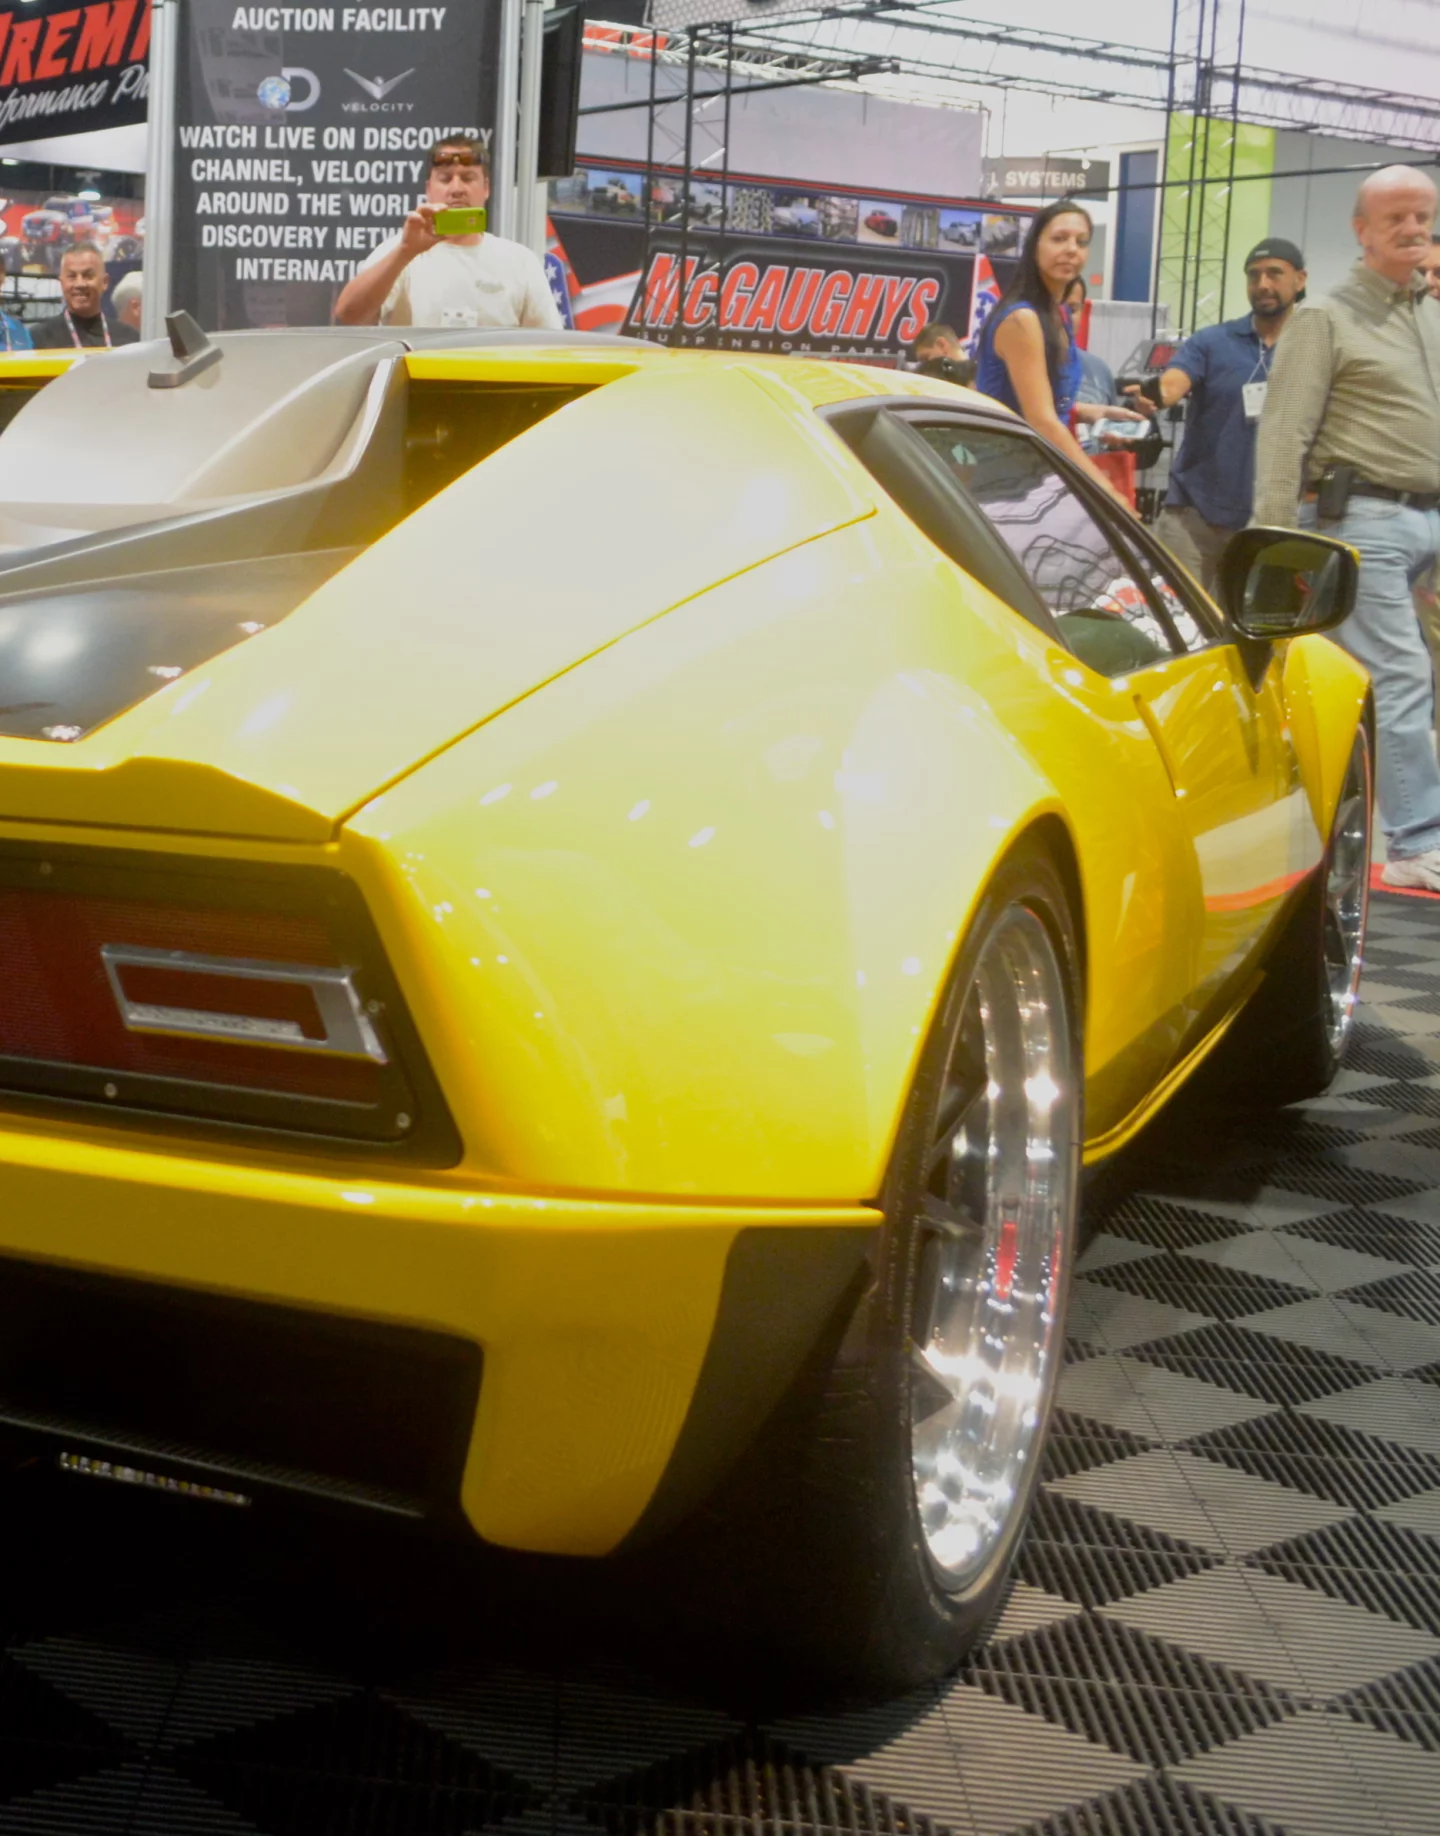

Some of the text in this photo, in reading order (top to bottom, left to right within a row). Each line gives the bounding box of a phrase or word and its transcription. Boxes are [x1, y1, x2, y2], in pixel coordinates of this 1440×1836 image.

[232, 8, 446, 31] AUCTION FACILITY
[341, 103, 415, 113] VELOCITY
[180, 126, 257, 148] WATCH
[264, 127, 316, 150] LIVE
[323, 127, 356, 150] ON
[191, 158, 423, 186] CHANNEL, VELOCITY
[1005, 170, 1086, 188] SYSTEMS
[196, 192, 426, 217] AROUND THE WORL
[202, 226, 328, 249] DISCOVERY
